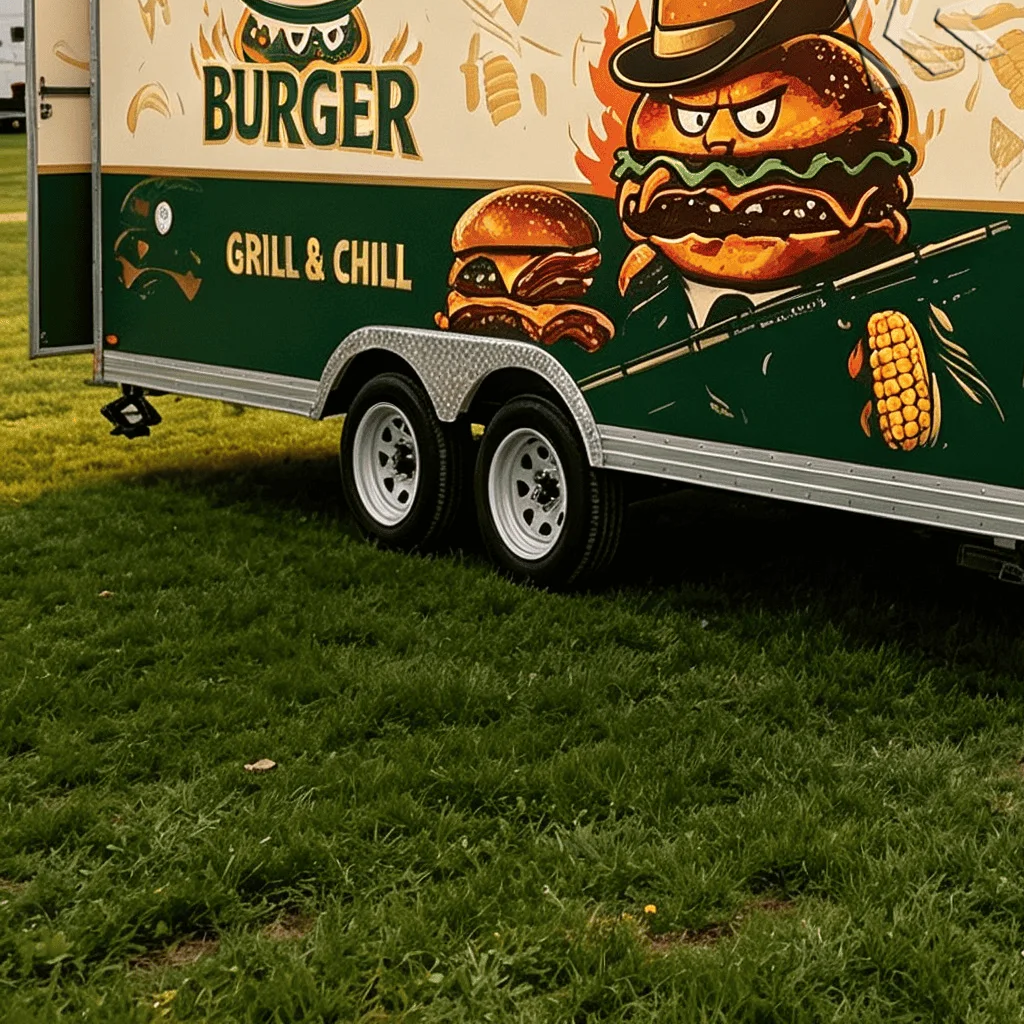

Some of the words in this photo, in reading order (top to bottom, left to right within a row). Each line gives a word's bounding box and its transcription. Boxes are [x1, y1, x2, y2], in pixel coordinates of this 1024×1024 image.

[202, 64, 422, 160] BURGER
[226, 231, 300, 279] GRILL
[305, 236, 325, 281] &
[333, 239, 412, 291] CHILL
